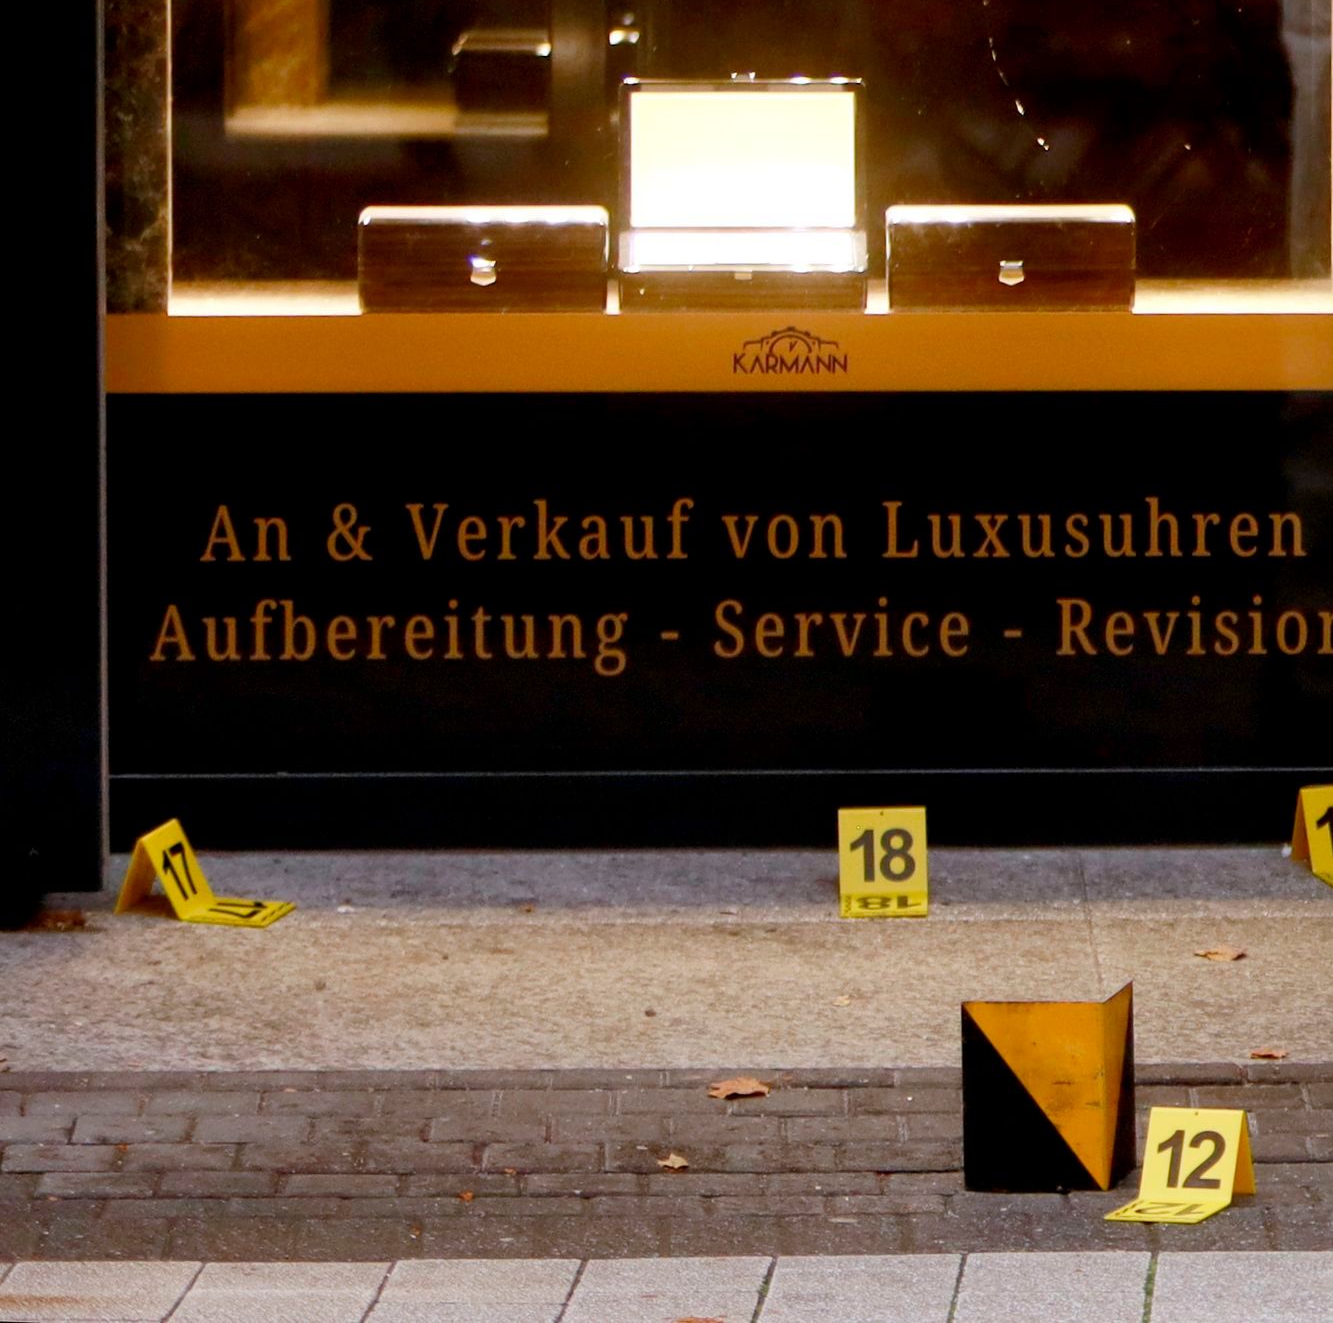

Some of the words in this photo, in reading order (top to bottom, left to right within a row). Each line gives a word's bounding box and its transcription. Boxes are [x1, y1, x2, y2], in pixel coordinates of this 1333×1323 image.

[732, 352, 848, 374] KARMANN
[200, 504, 291, 562] An
[326, 503, 372, 562] &
[405, 497, 695, 561] Verkauf
[721, 514, 847, 559] von
[882, 496, 1307, 559] Luxusuhren
[149, 598, 628, 677] Aufbereitung
[713, 596, 970, 659] Service
[162, 841, 198, 901] 17
[850, 828, 916, 883] 18
[1157, 1130, 1226, 1189] 12
